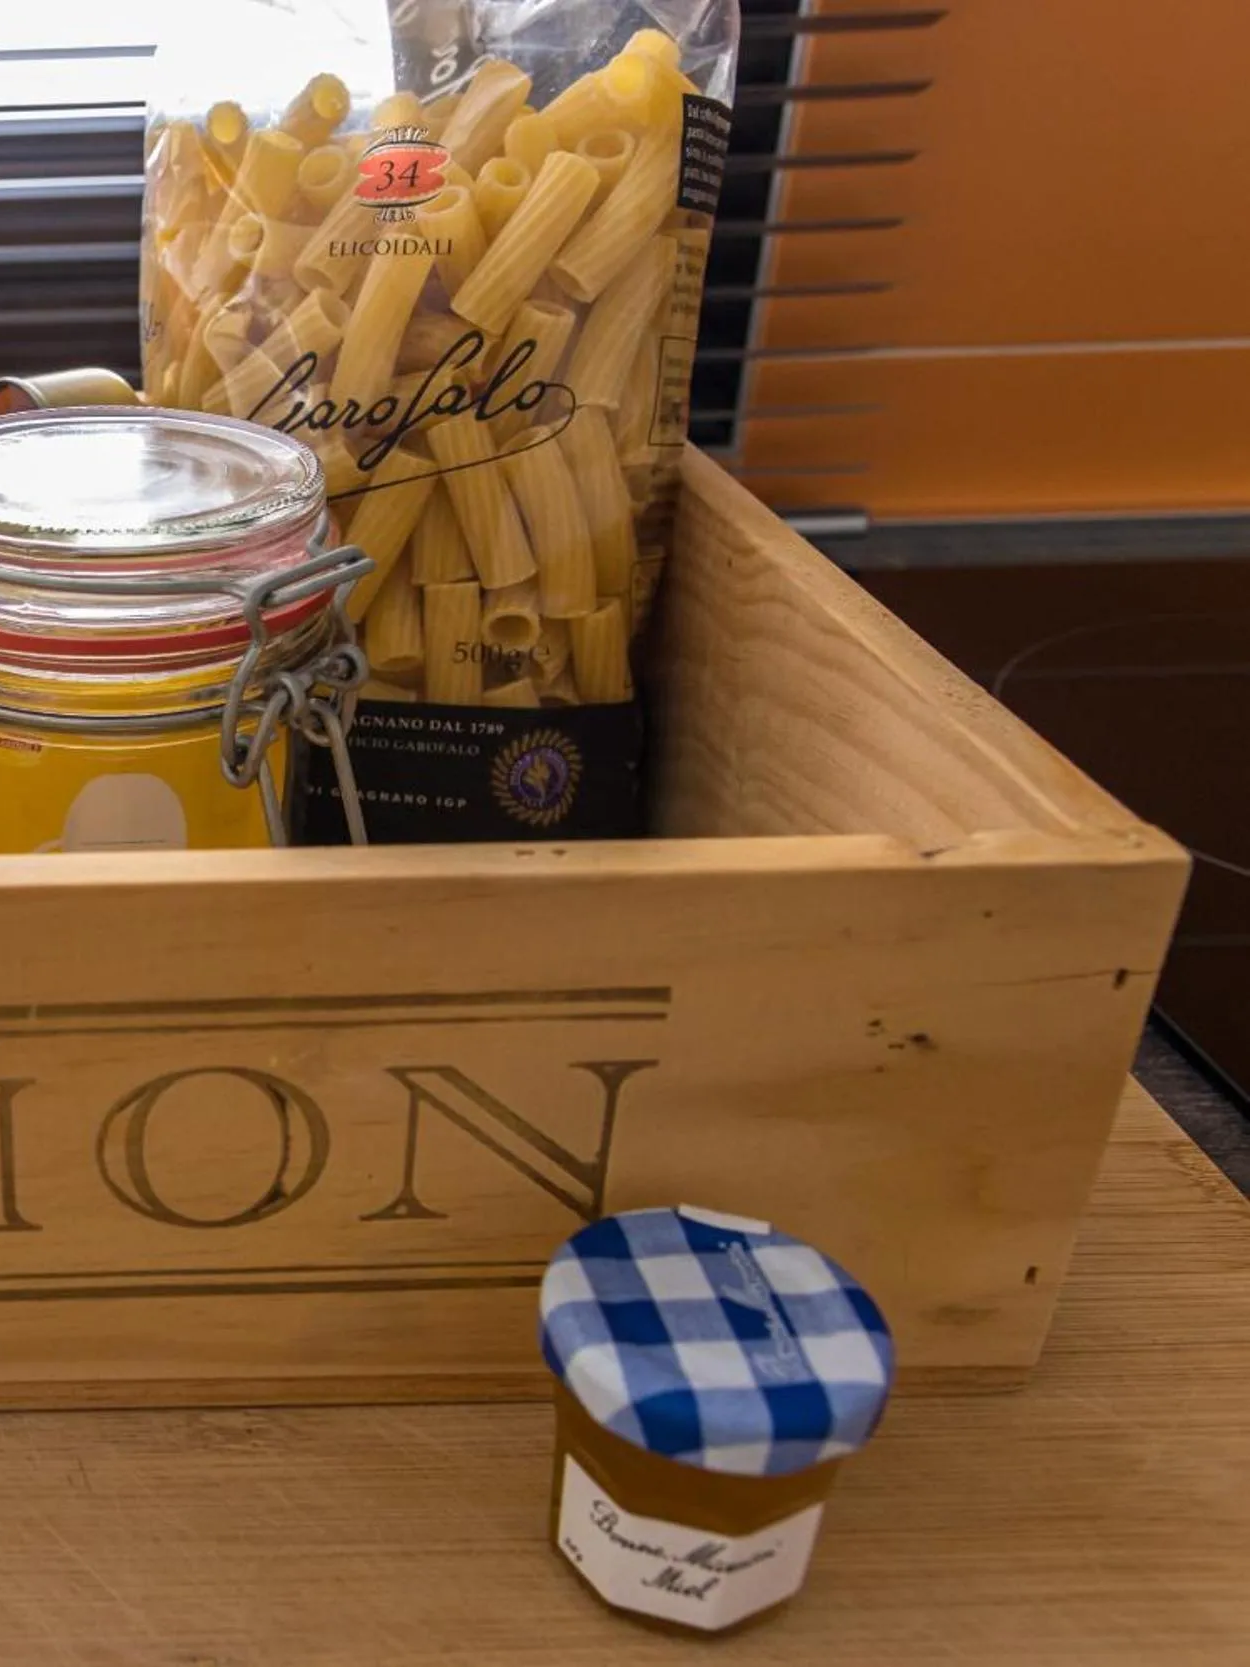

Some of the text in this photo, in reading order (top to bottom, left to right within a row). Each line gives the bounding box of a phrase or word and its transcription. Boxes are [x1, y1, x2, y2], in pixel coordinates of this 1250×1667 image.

[376, 159, 421, 192] 34
[329, 238, 454, 258] ELICOIDALI
[246, 330, 564, 472] Garofalo
[352, 714, 424, 731] AGNANO
[429, 719, 466, 734] DAL
[348, 735, 390, 750] ICIO
[330, 786, 428, 805] GAGNANO
